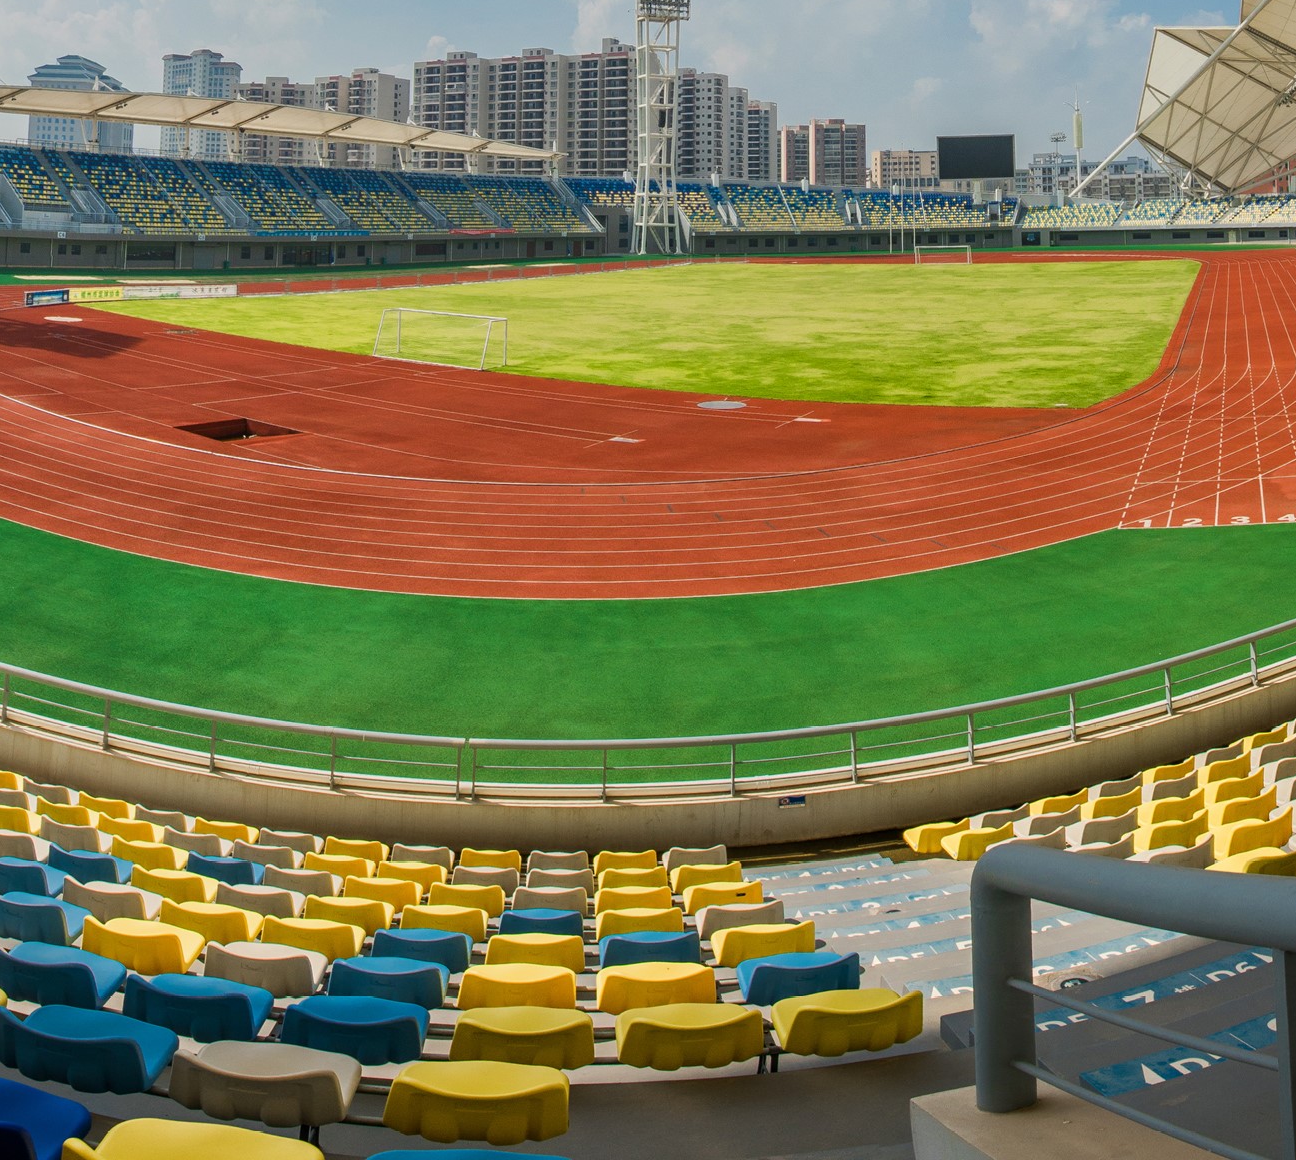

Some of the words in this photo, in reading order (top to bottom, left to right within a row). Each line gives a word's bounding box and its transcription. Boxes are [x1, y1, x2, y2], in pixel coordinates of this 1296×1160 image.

[1138, 519, 1152, 528] 1
[1182, 517, 1203, 527] 2
[1231, 515, 1251, 525] 3
